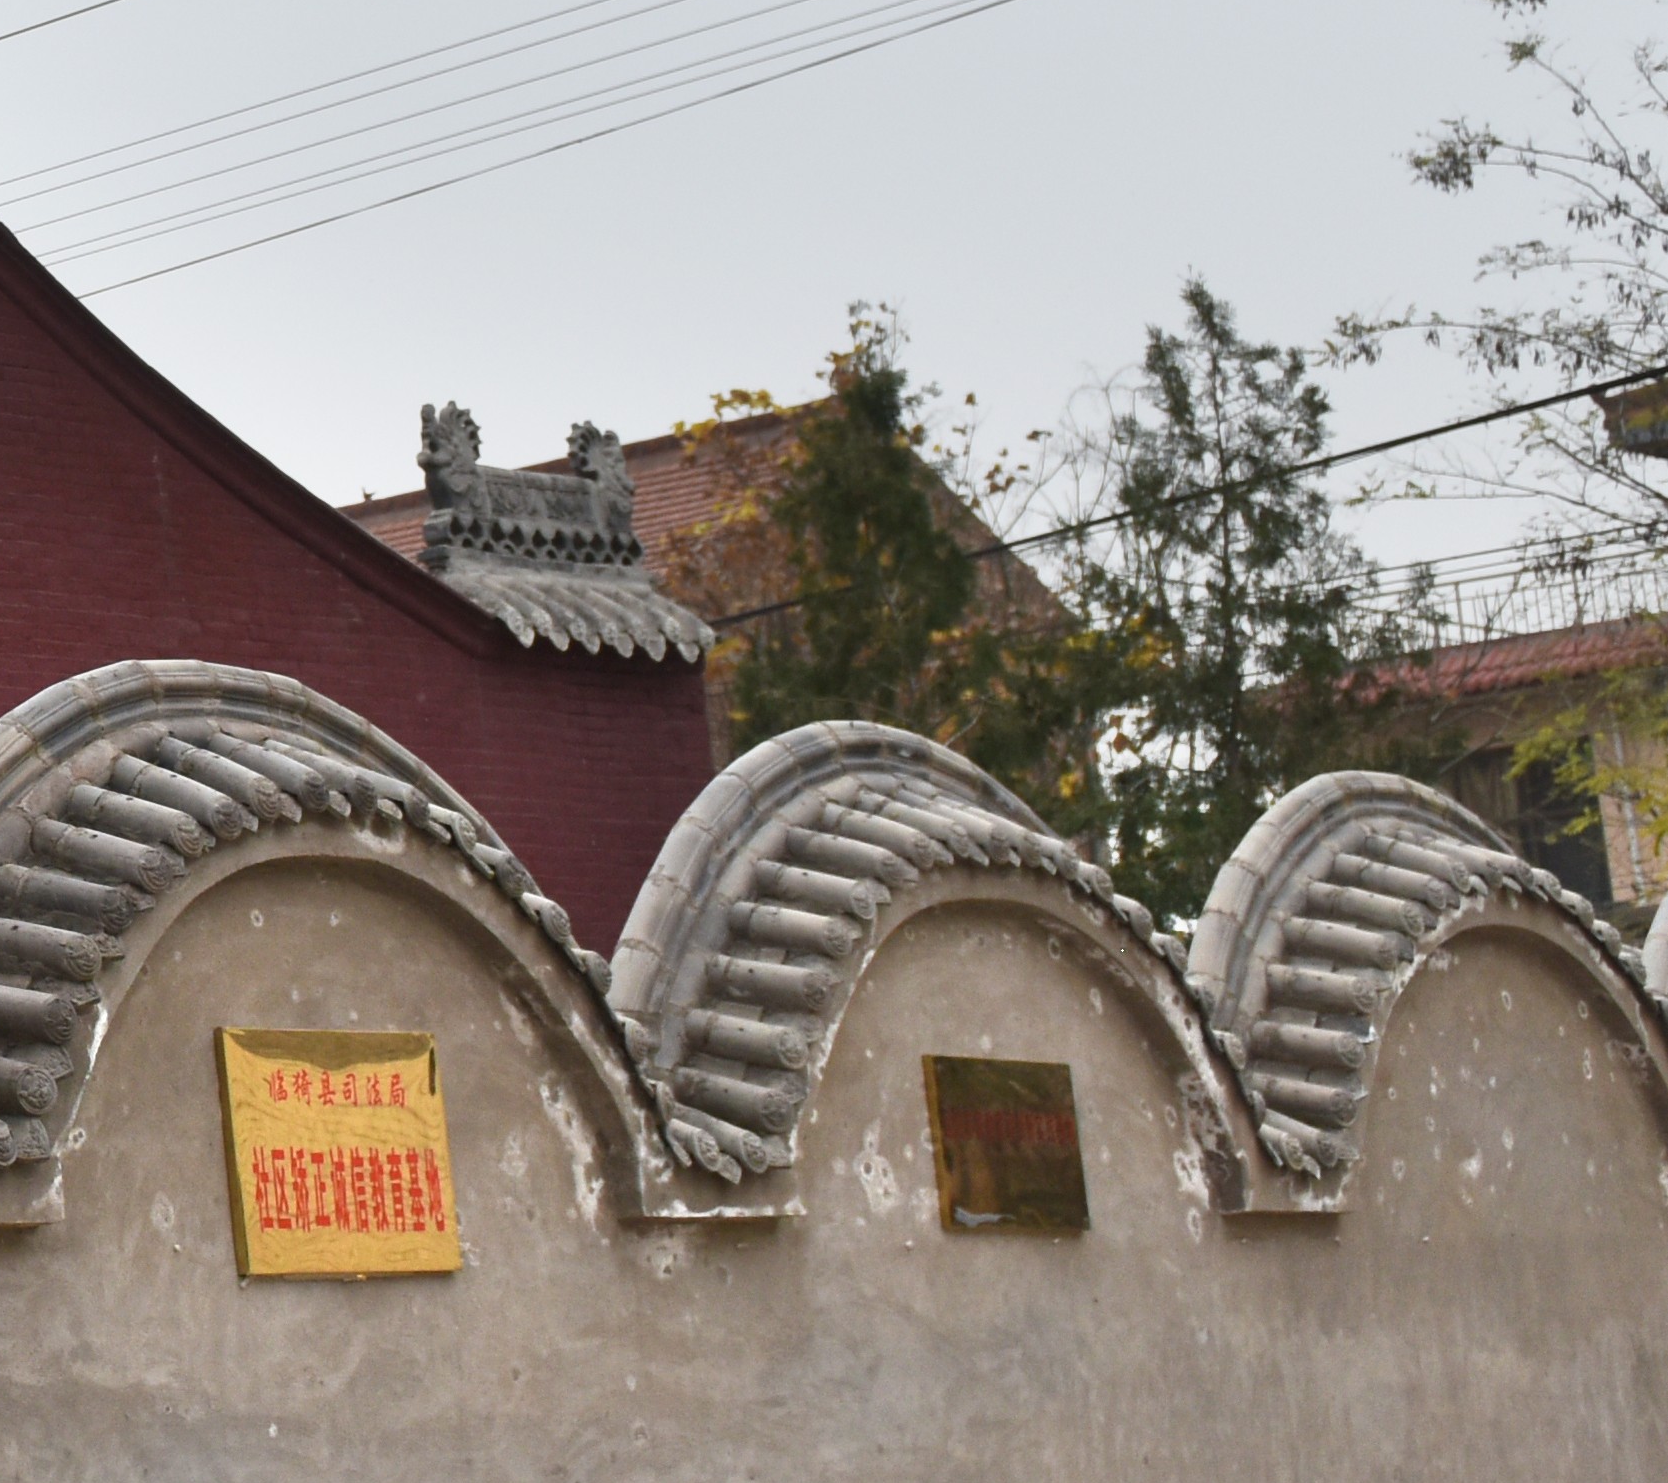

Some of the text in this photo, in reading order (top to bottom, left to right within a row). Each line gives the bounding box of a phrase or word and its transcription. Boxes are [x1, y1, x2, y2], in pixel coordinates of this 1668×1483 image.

[269, 1069, 407, 1108] 临猗县司法局
